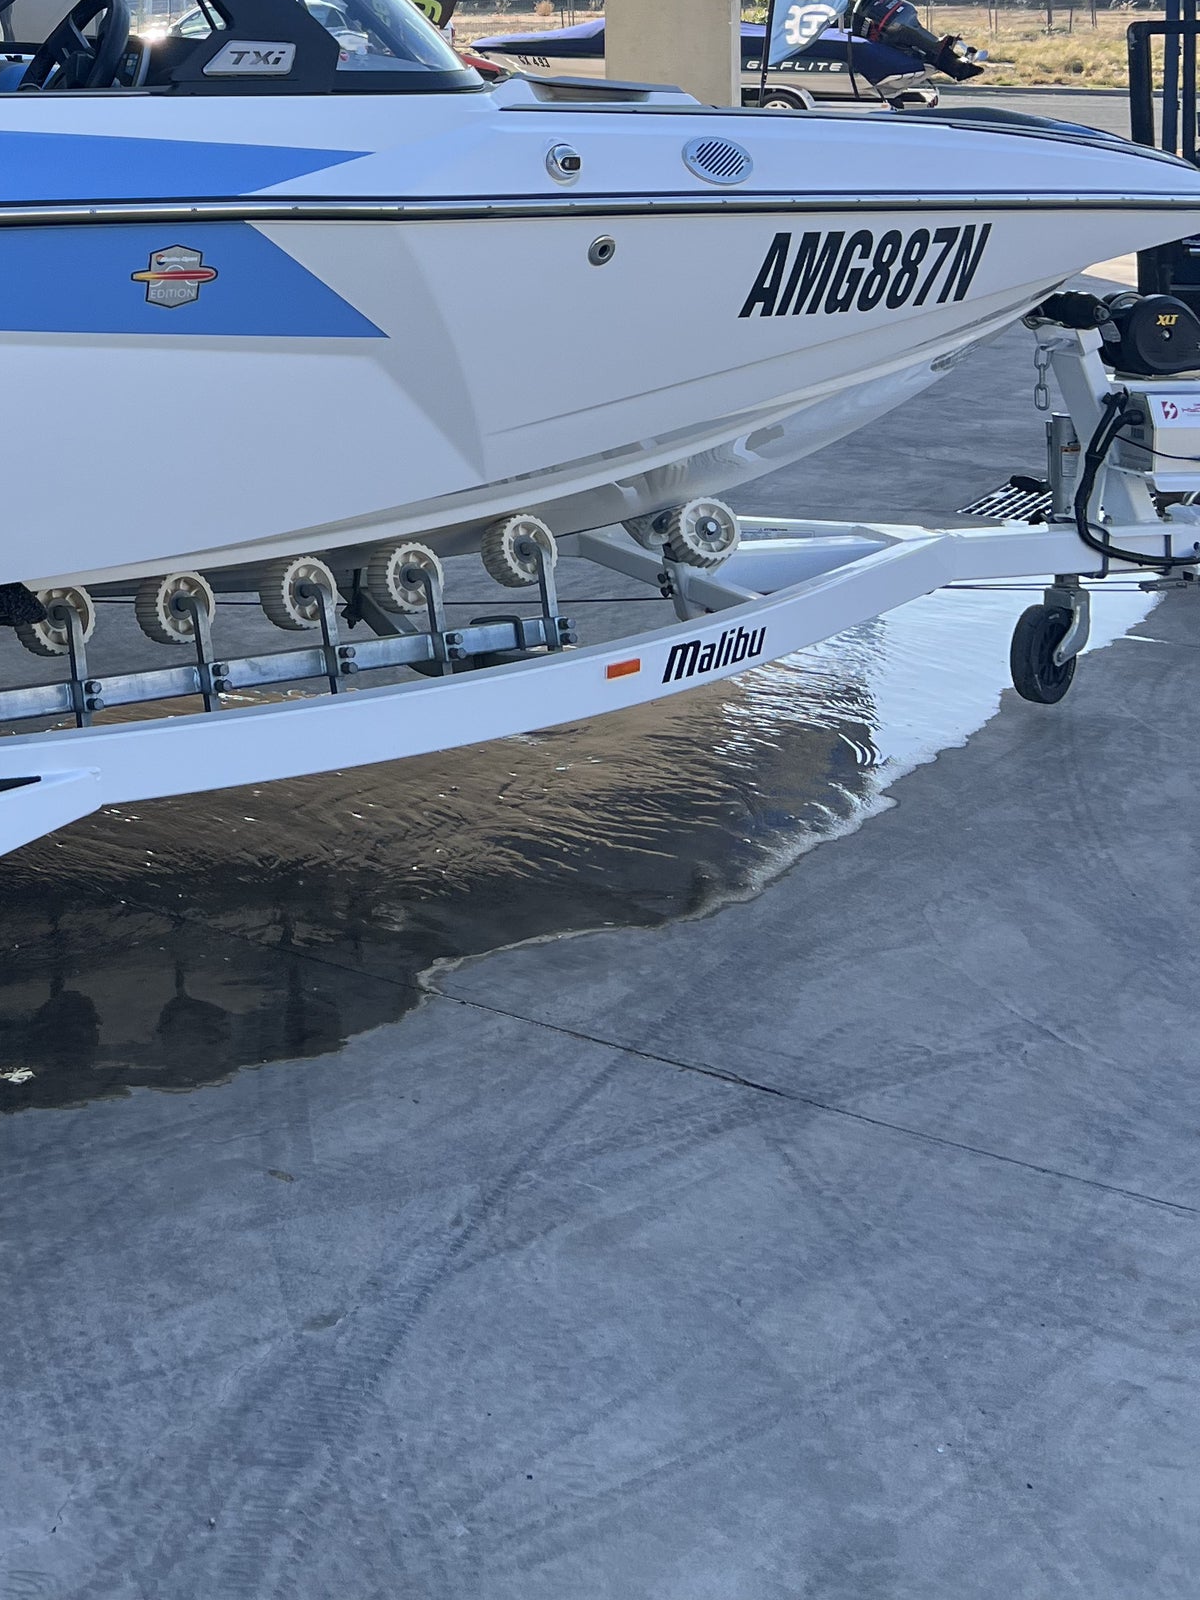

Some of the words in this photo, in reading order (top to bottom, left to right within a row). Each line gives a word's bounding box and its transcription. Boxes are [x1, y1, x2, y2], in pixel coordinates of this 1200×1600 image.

[738, 223, 992, 318] AMG887N
[150, 288, 195, 299] EDITION
[1156, 314, 1179, 326] XLT
[662, 626, 767, 684] Malibu
